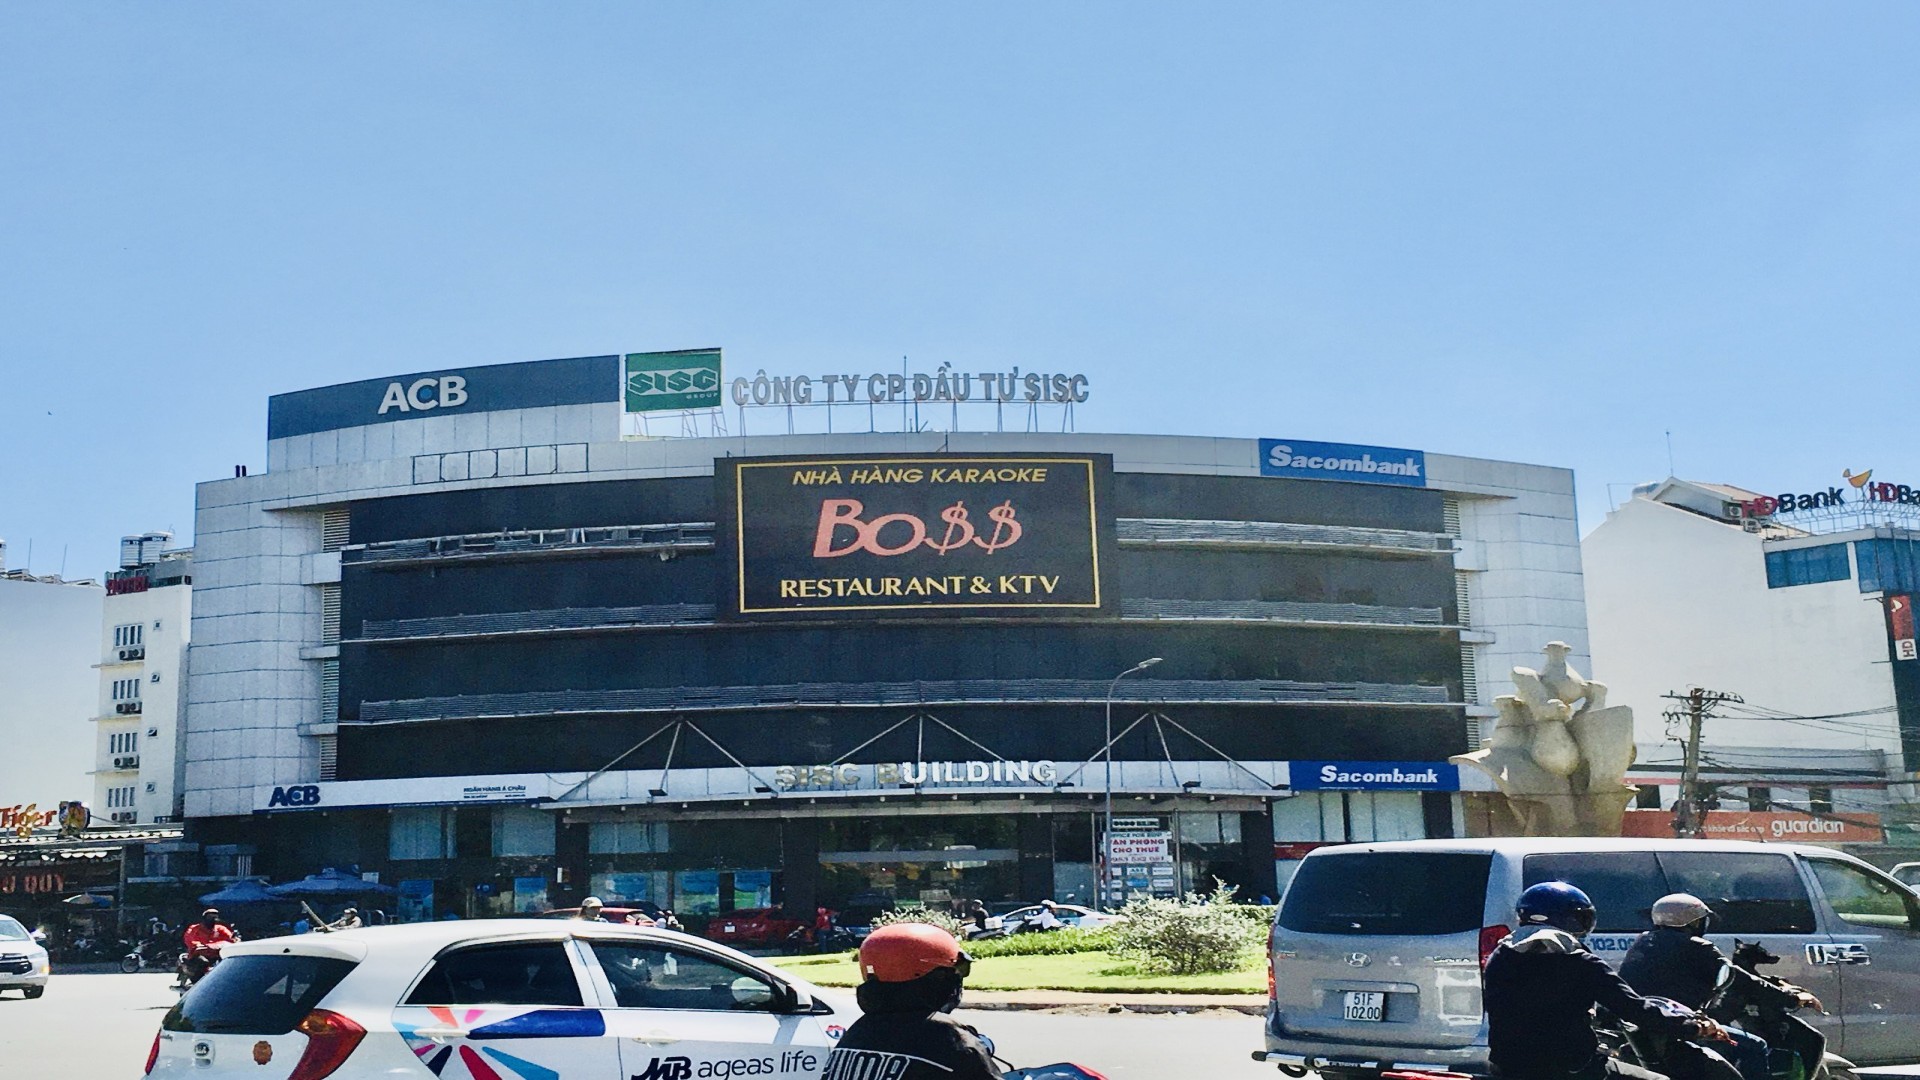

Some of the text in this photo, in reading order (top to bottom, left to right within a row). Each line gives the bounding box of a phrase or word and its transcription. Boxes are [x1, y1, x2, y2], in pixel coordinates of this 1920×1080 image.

[378, 375, 468, 415] ACB
[731, 361, 1090, 406] CÔNG TY CP ĐẦU TƯ SISC
[1268, 445, 1421, 477] Sacombank
[792, 464, 1047, 486] NHÀ HÀNG KARAOKE
[1741, 487, 1844, 516] HDBank
[780, 575, 1060, 598] RESTAURANT & KTV
[775, 760, 1057, 787] SISC BUILDING
[1319, 765, 1438, 784] Sacombank
[268, 785, 321, 807] ACB
[0, 804, 57, 837] Tiger
[1770, 817, 1845, 837] guardian
[1353, 993, 1374, 1005] 51F
[697, 1057, 775, 1080] ageas
[780, 1050, 817, 1073] life
